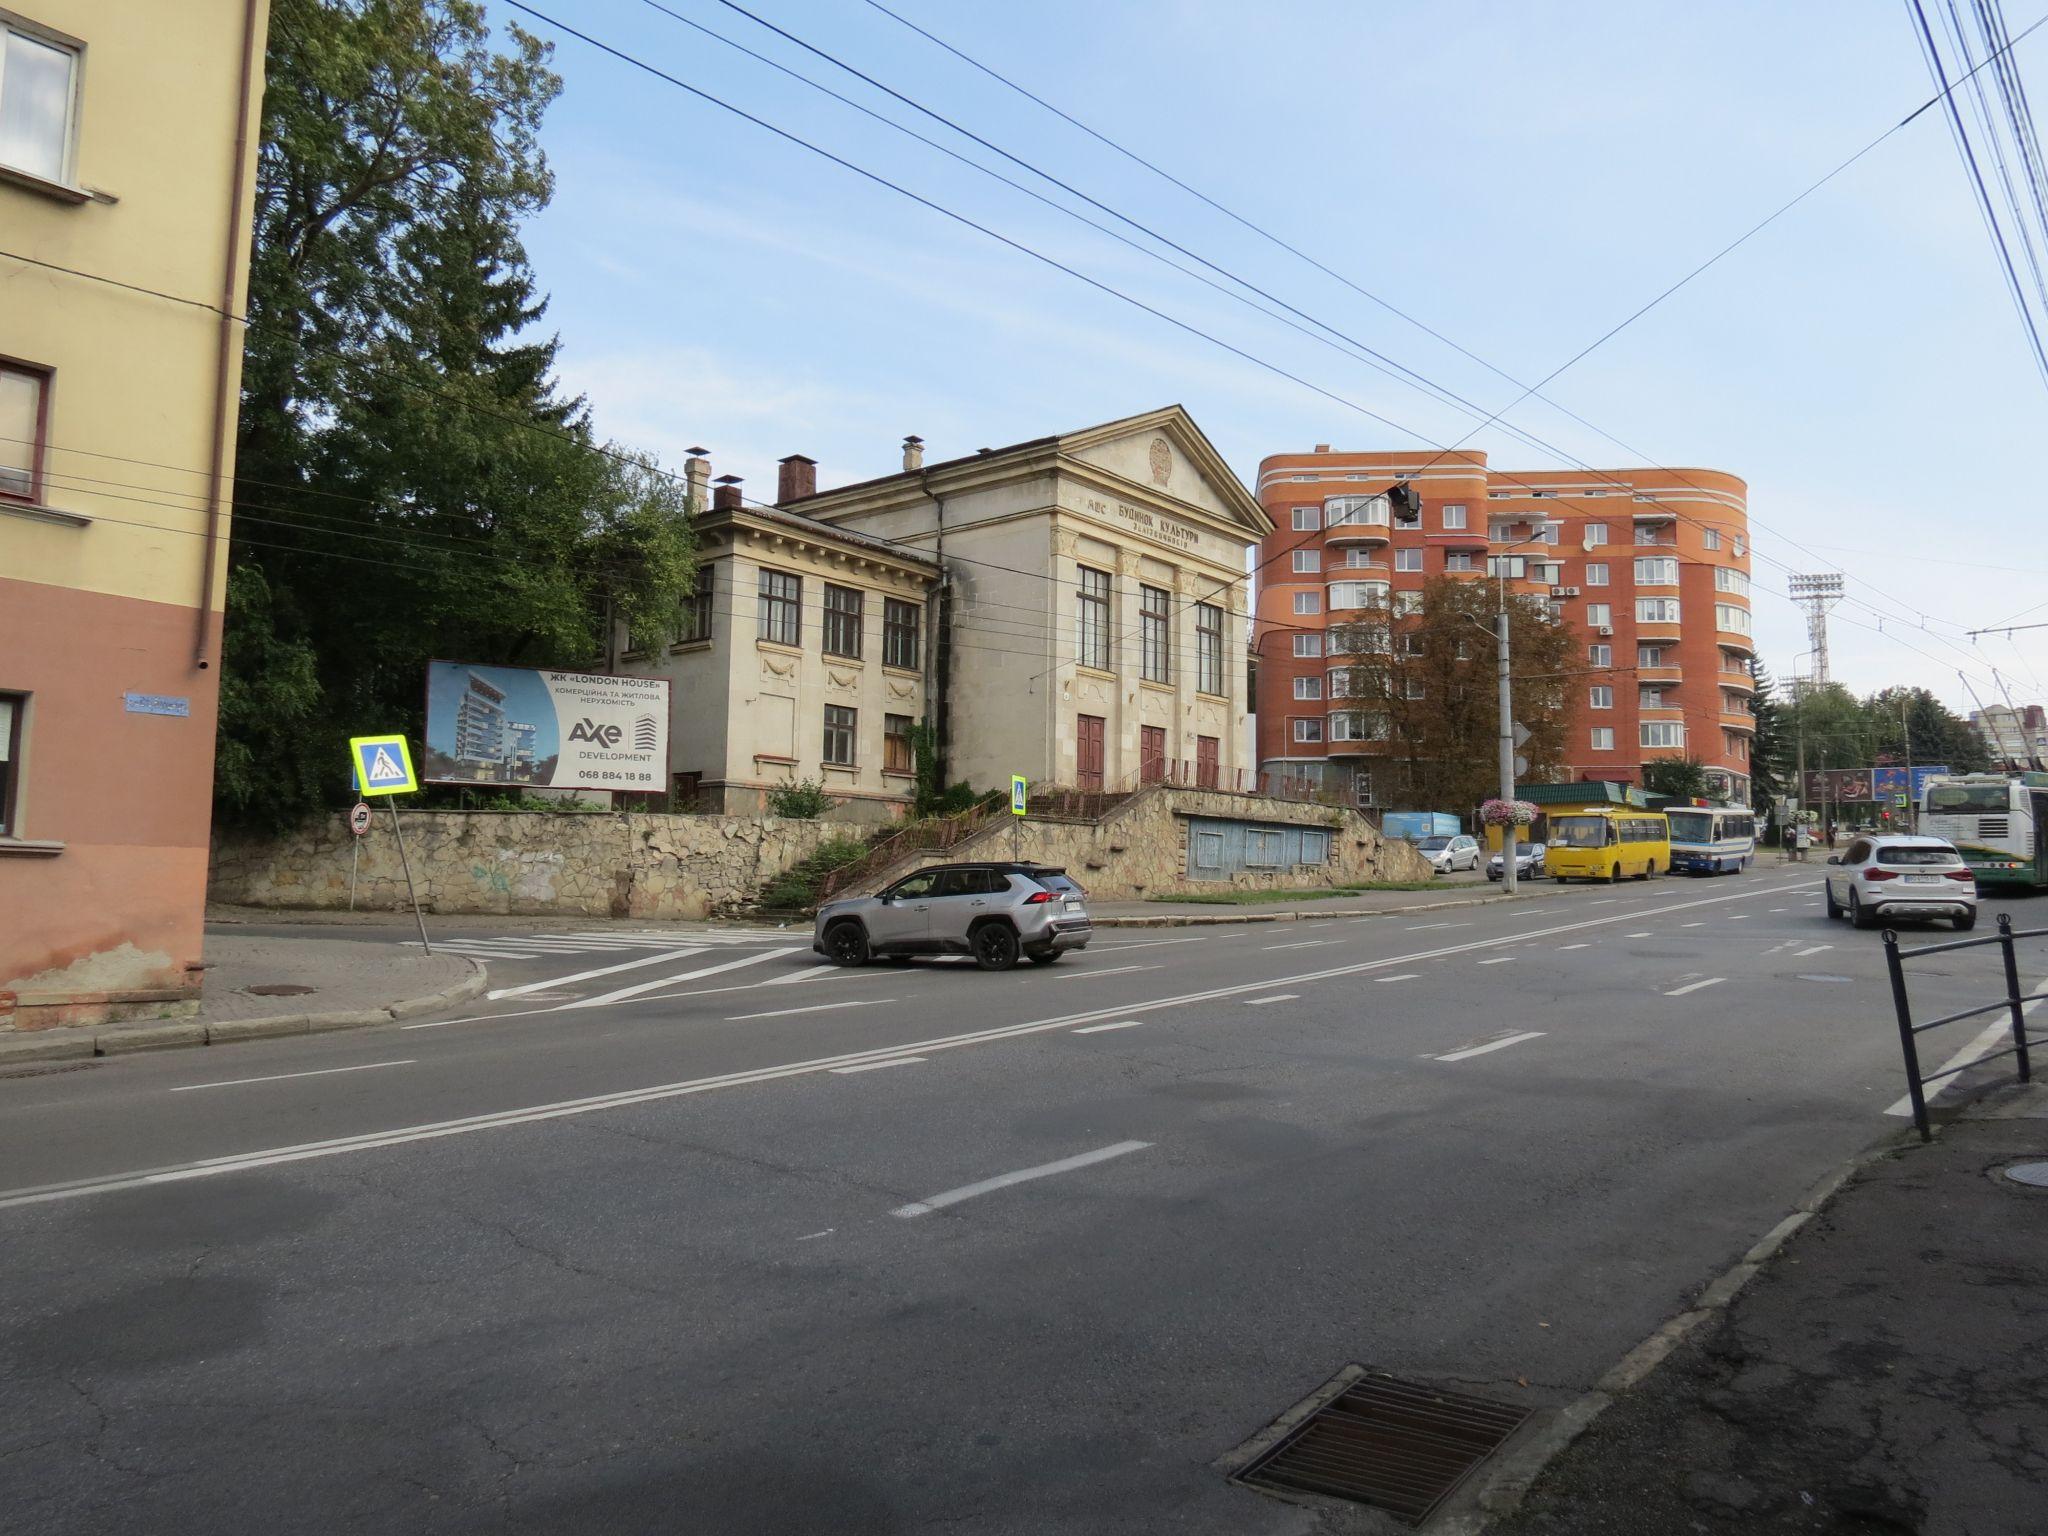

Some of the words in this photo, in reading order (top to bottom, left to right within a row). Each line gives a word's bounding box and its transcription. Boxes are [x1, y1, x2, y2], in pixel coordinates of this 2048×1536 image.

[1118, 504, 1153, 527] БУДИНОК
[1160, 519, 1199, 544] КУЛЬТУРИ
[550, 673, 567, 682] ЖК
[621, 691, 661, 701] ЖИТЛОВА
[580, 698, 636, 707] НЕРУХОМІСТЬ
[579, 751, 652, 762] DEVELOPMENT
[578, 770, 599, 779] 068
[602, 771, 622, 780] 884
[625, 772, 636, 781] 18
[638, 773, 652, 781] 88
